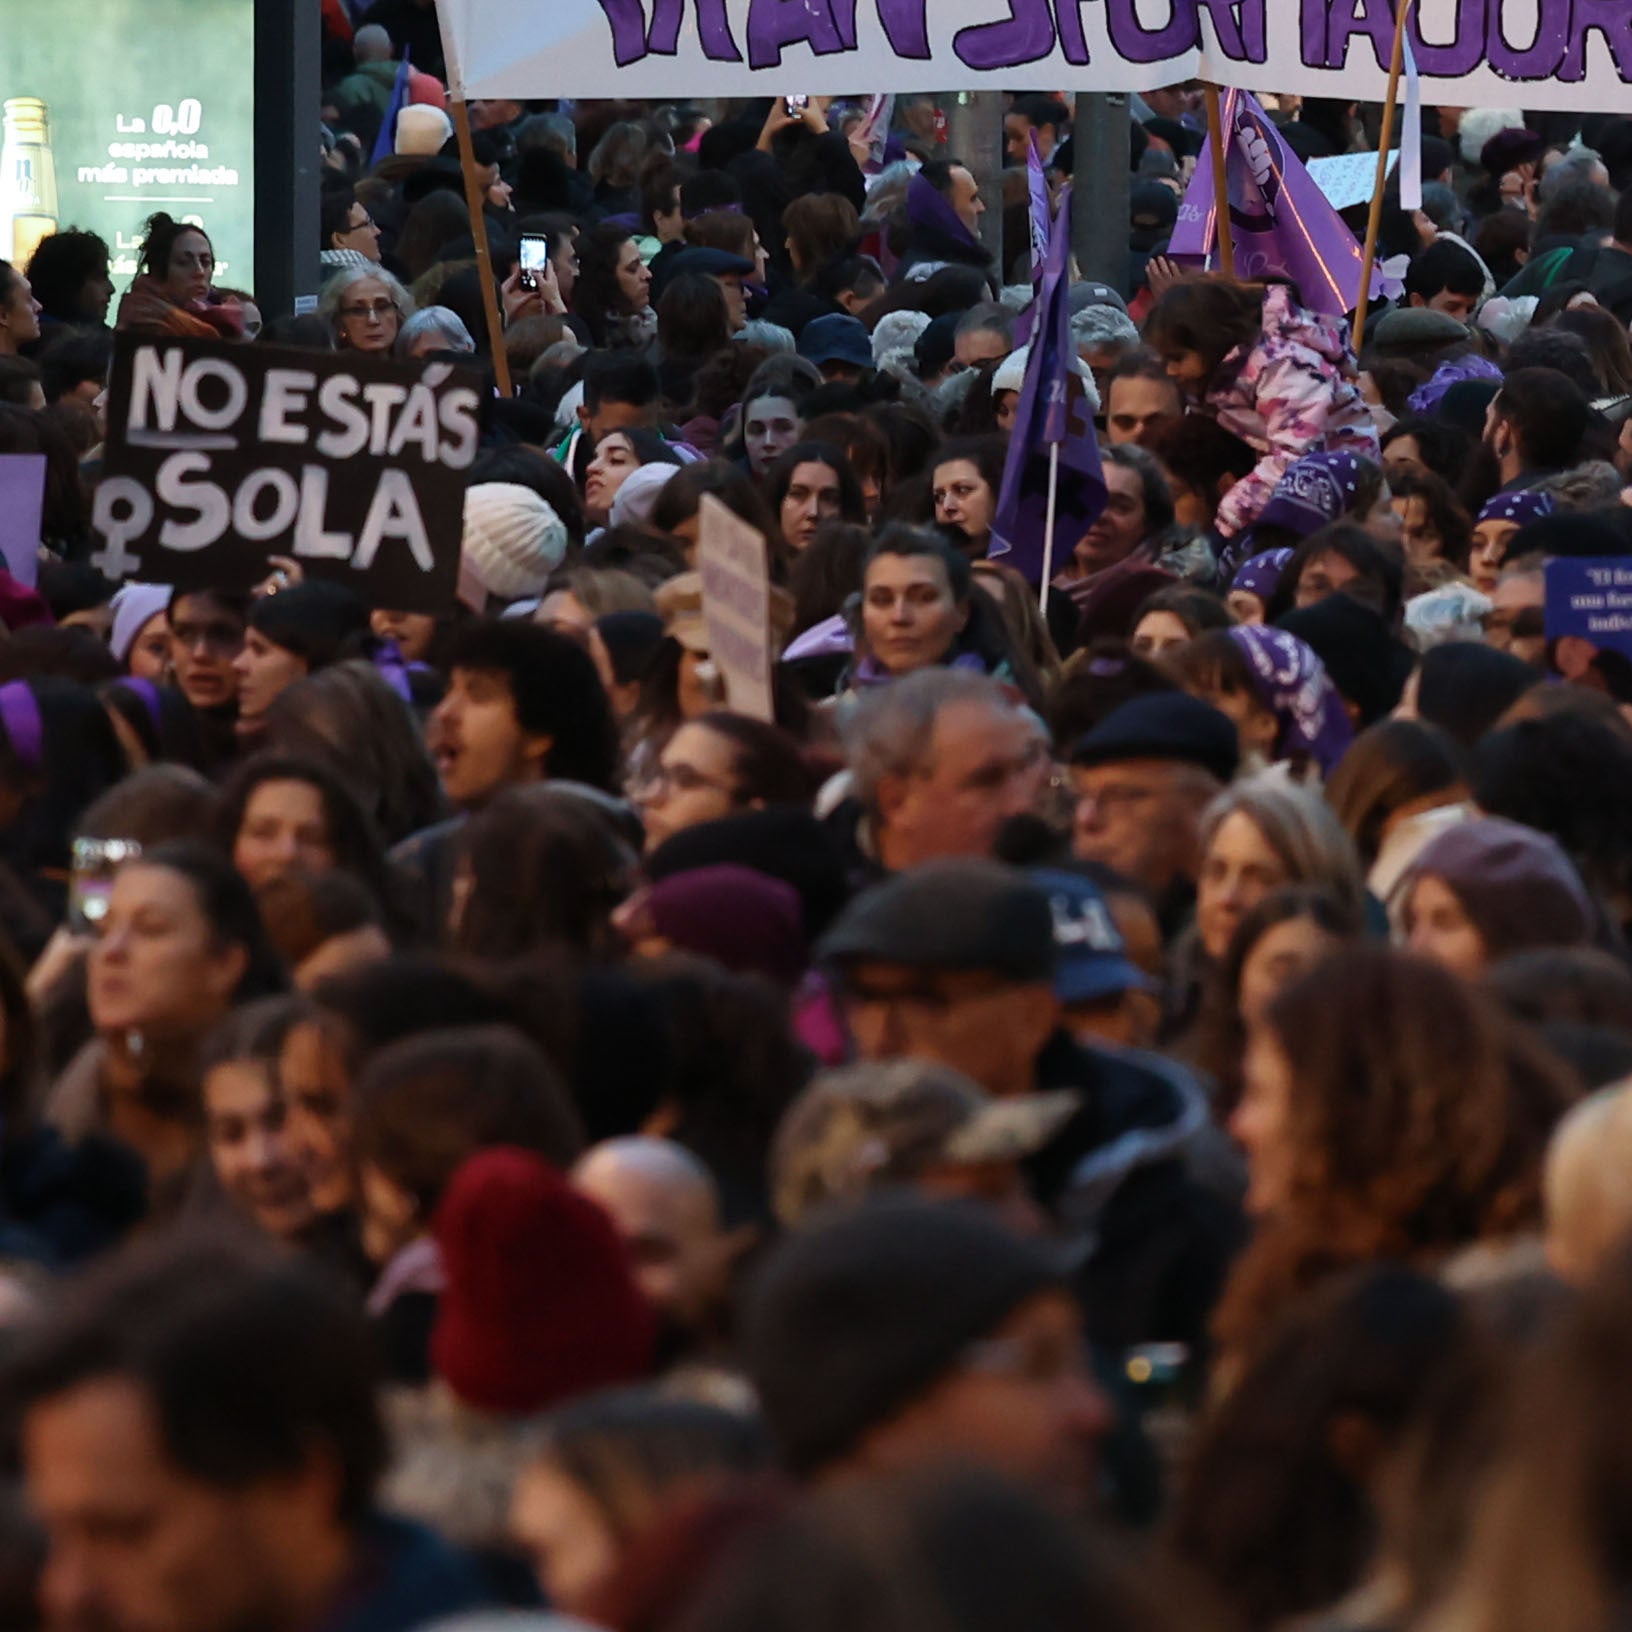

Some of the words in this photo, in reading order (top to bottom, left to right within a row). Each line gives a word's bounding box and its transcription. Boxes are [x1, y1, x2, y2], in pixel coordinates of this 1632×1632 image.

[116, 114, 145, 133] La
[152, 99, 202, 136] 0,0
[108, 140, 208, 160] española
[78, 163, 128, 184] más
[133, 165, 239, 187] premiada
[126, 345, 248, 435] NO
[259, 364, 481, 468] ESTÁS
[156, 453, 435, 571] SOLA
